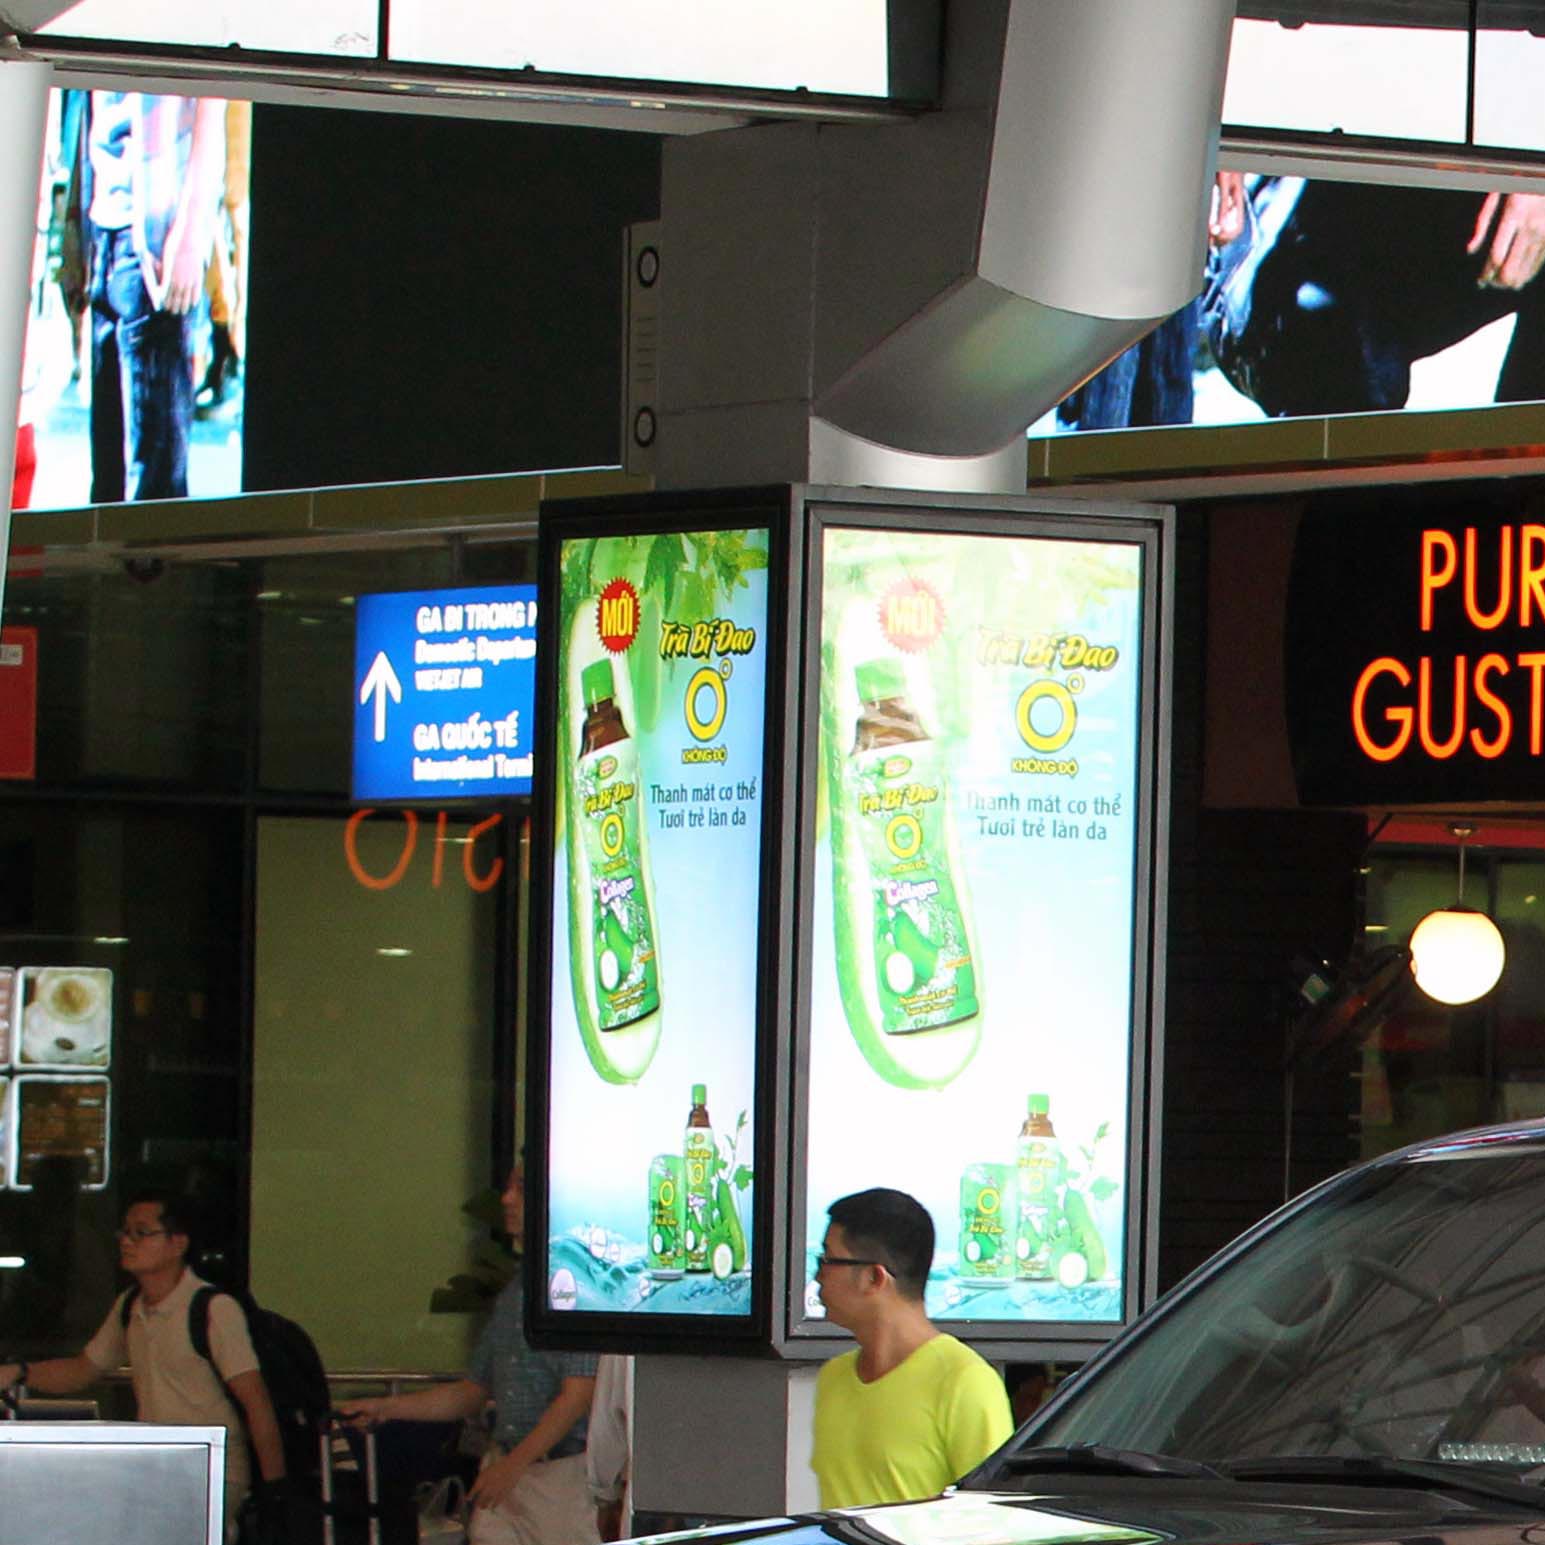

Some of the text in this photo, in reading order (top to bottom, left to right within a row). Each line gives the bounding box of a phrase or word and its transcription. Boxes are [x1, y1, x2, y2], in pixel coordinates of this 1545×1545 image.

[416, 605, 443, 634] GA
[464, 601, 526, 631] TRONG
[601, 589, 634, 637] MỚI
[661, 621, 691, 660] Trà
[716, 619, 756, 656] Đao
[1058, 635, 1118, 672] Đao
[413, 710, 519, 752] GA QUỐC TẾ
[1011, 756, 1057, 776] KHÔNG
[651, 782, 688, 805] Thanh
[692, 781, 716, 802] mát
[1027, 795, 1062, 814] mát
[1094, 792, 1122, 817] thể
[731, 806, 748, 826] da
[1052, 818, 1080, 840] làn
[1086, 820, 1109, 841] da
